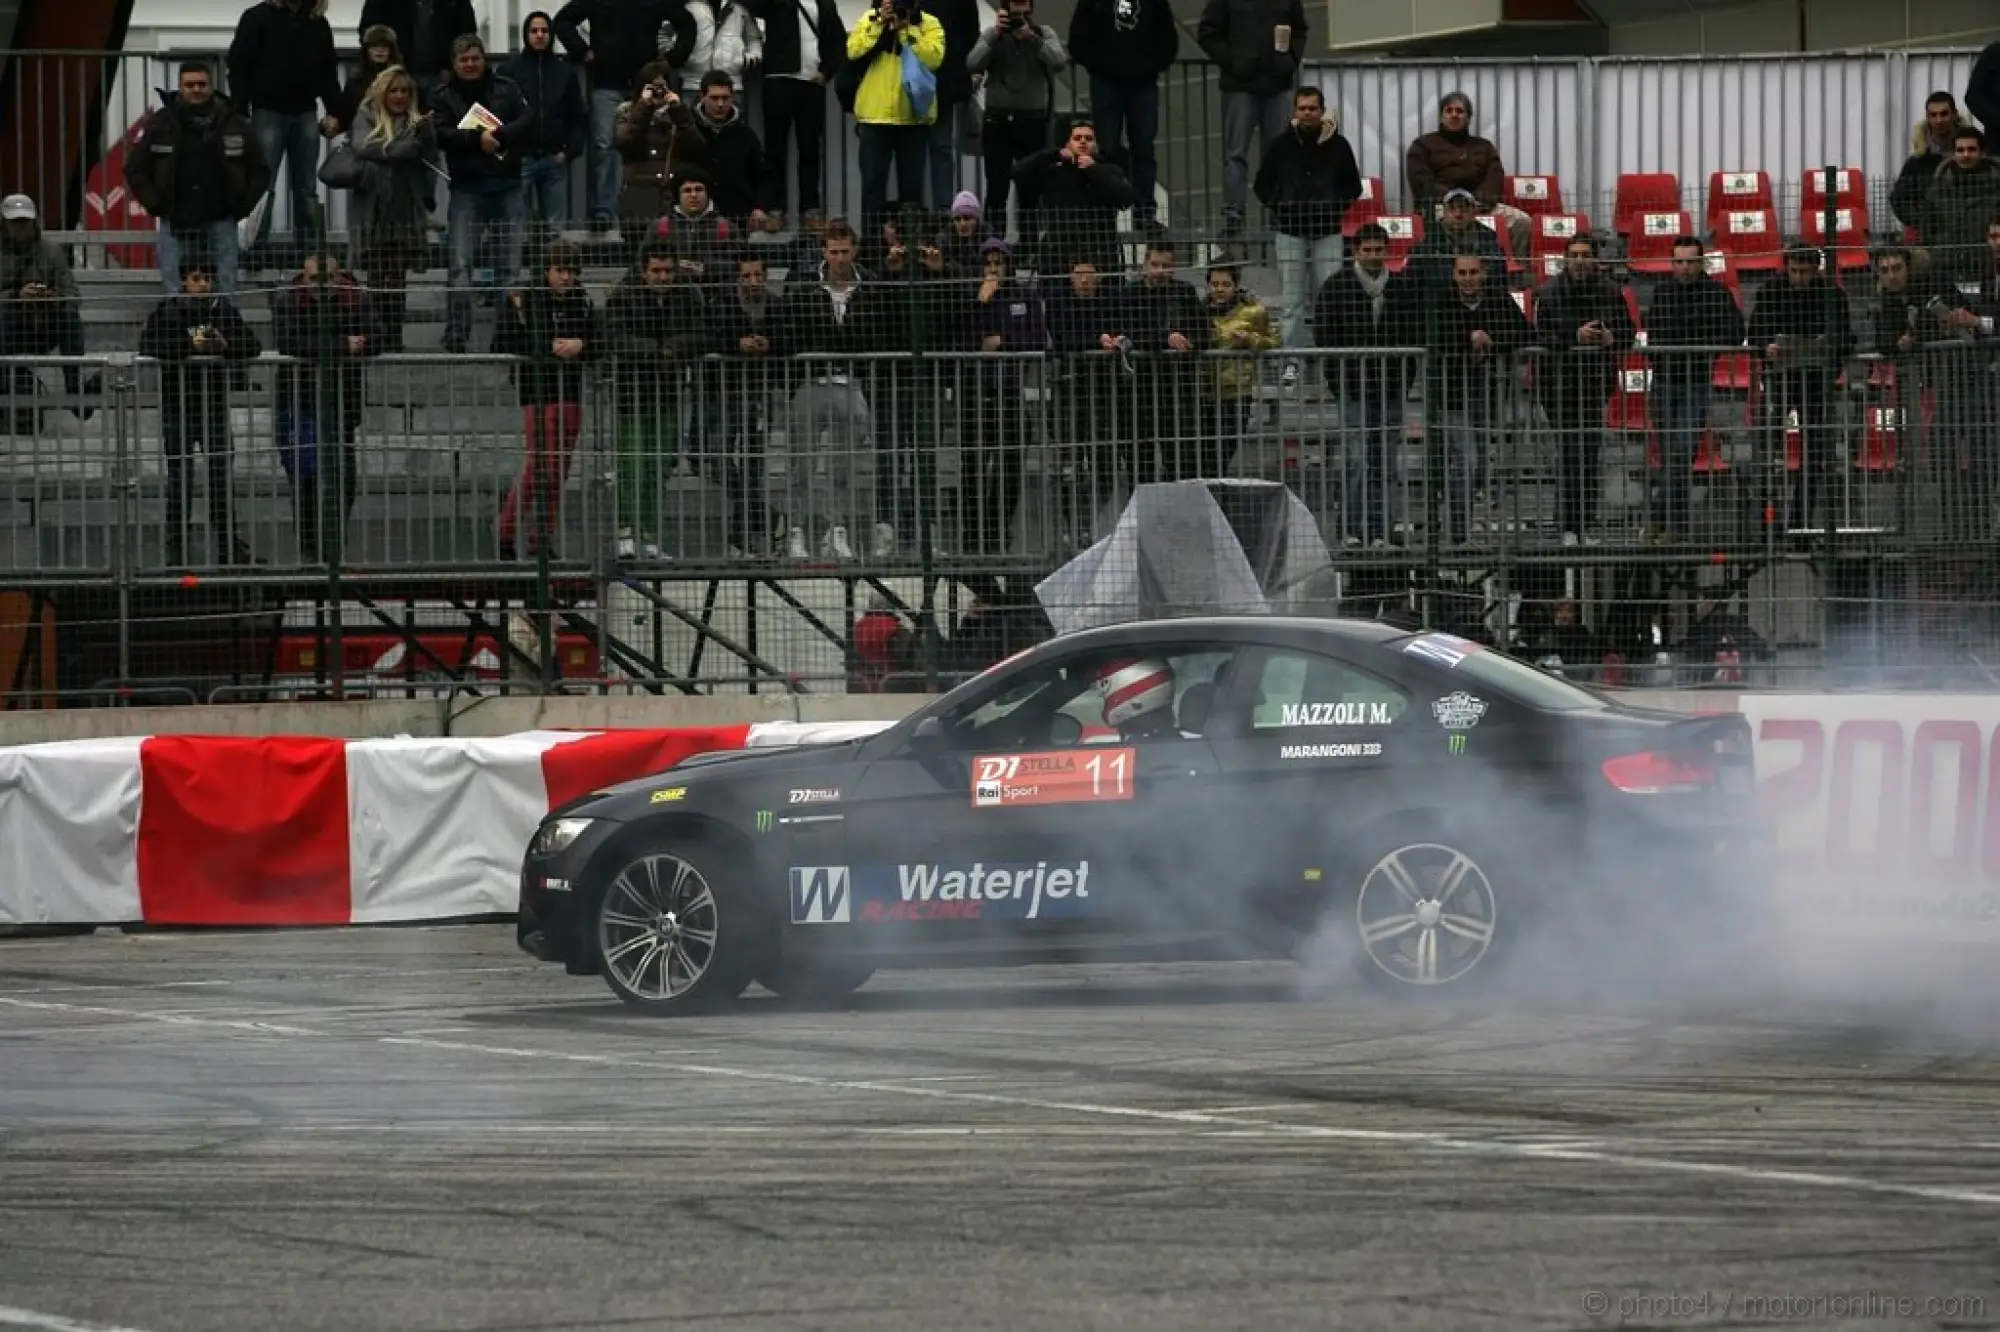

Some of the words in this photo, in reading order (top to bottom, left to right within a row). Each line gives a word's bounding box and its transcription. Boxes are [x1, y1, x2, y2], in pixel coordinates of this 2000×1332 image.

[1281, 702, 1365, 726] MAZZOLI
[1370, 702, 1392, 724] M.
[1280, 744, 1362, 758] MARANGONI
[1021, 757, 1076, 774] STELLA
[1085, 753, 1126, 795] 11
[978, 785, 999, 798] Rai
[1003, 785, 1038, 800] Sport
[1757, 719, 2000, 878] 200
[899, 860, 1089, 919] Waterjet
[859, 899, 984, 922] RACING
